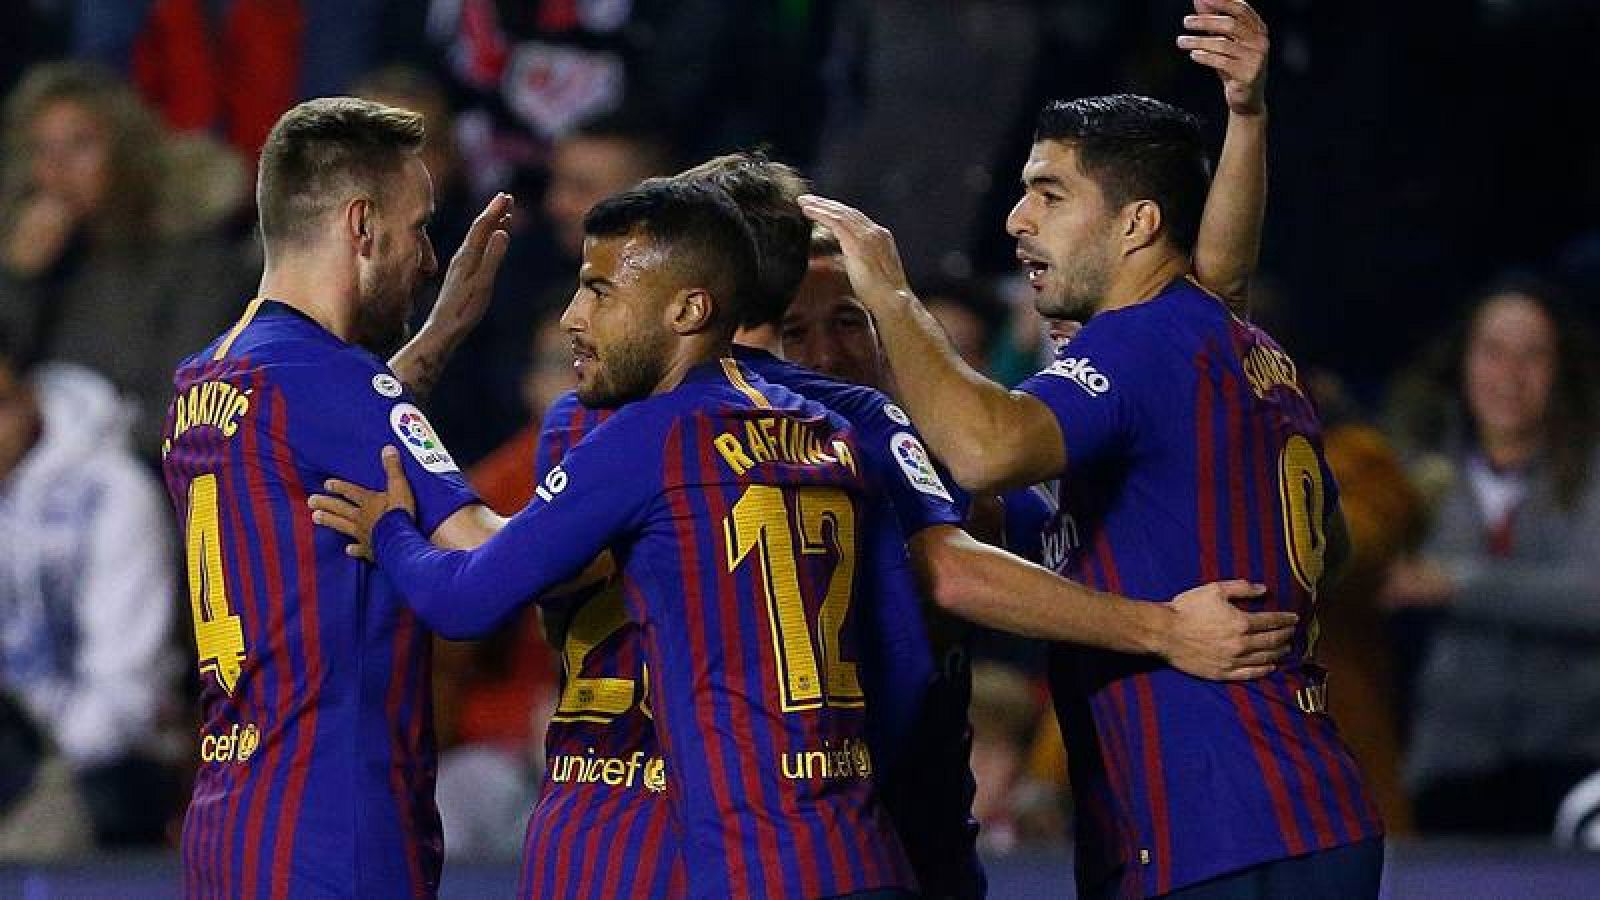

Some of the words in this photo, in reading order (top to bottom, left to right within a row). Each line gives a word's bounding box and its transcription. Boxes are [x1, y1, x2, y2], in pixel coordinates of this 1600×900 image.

[186, 473, 247, 698] 4
[723, 483, 866, 713] 12
[1278, 433, 1327, 658] 9
[201, 723, 240, 762] cef
[552, 748, 645, 787] unicef
